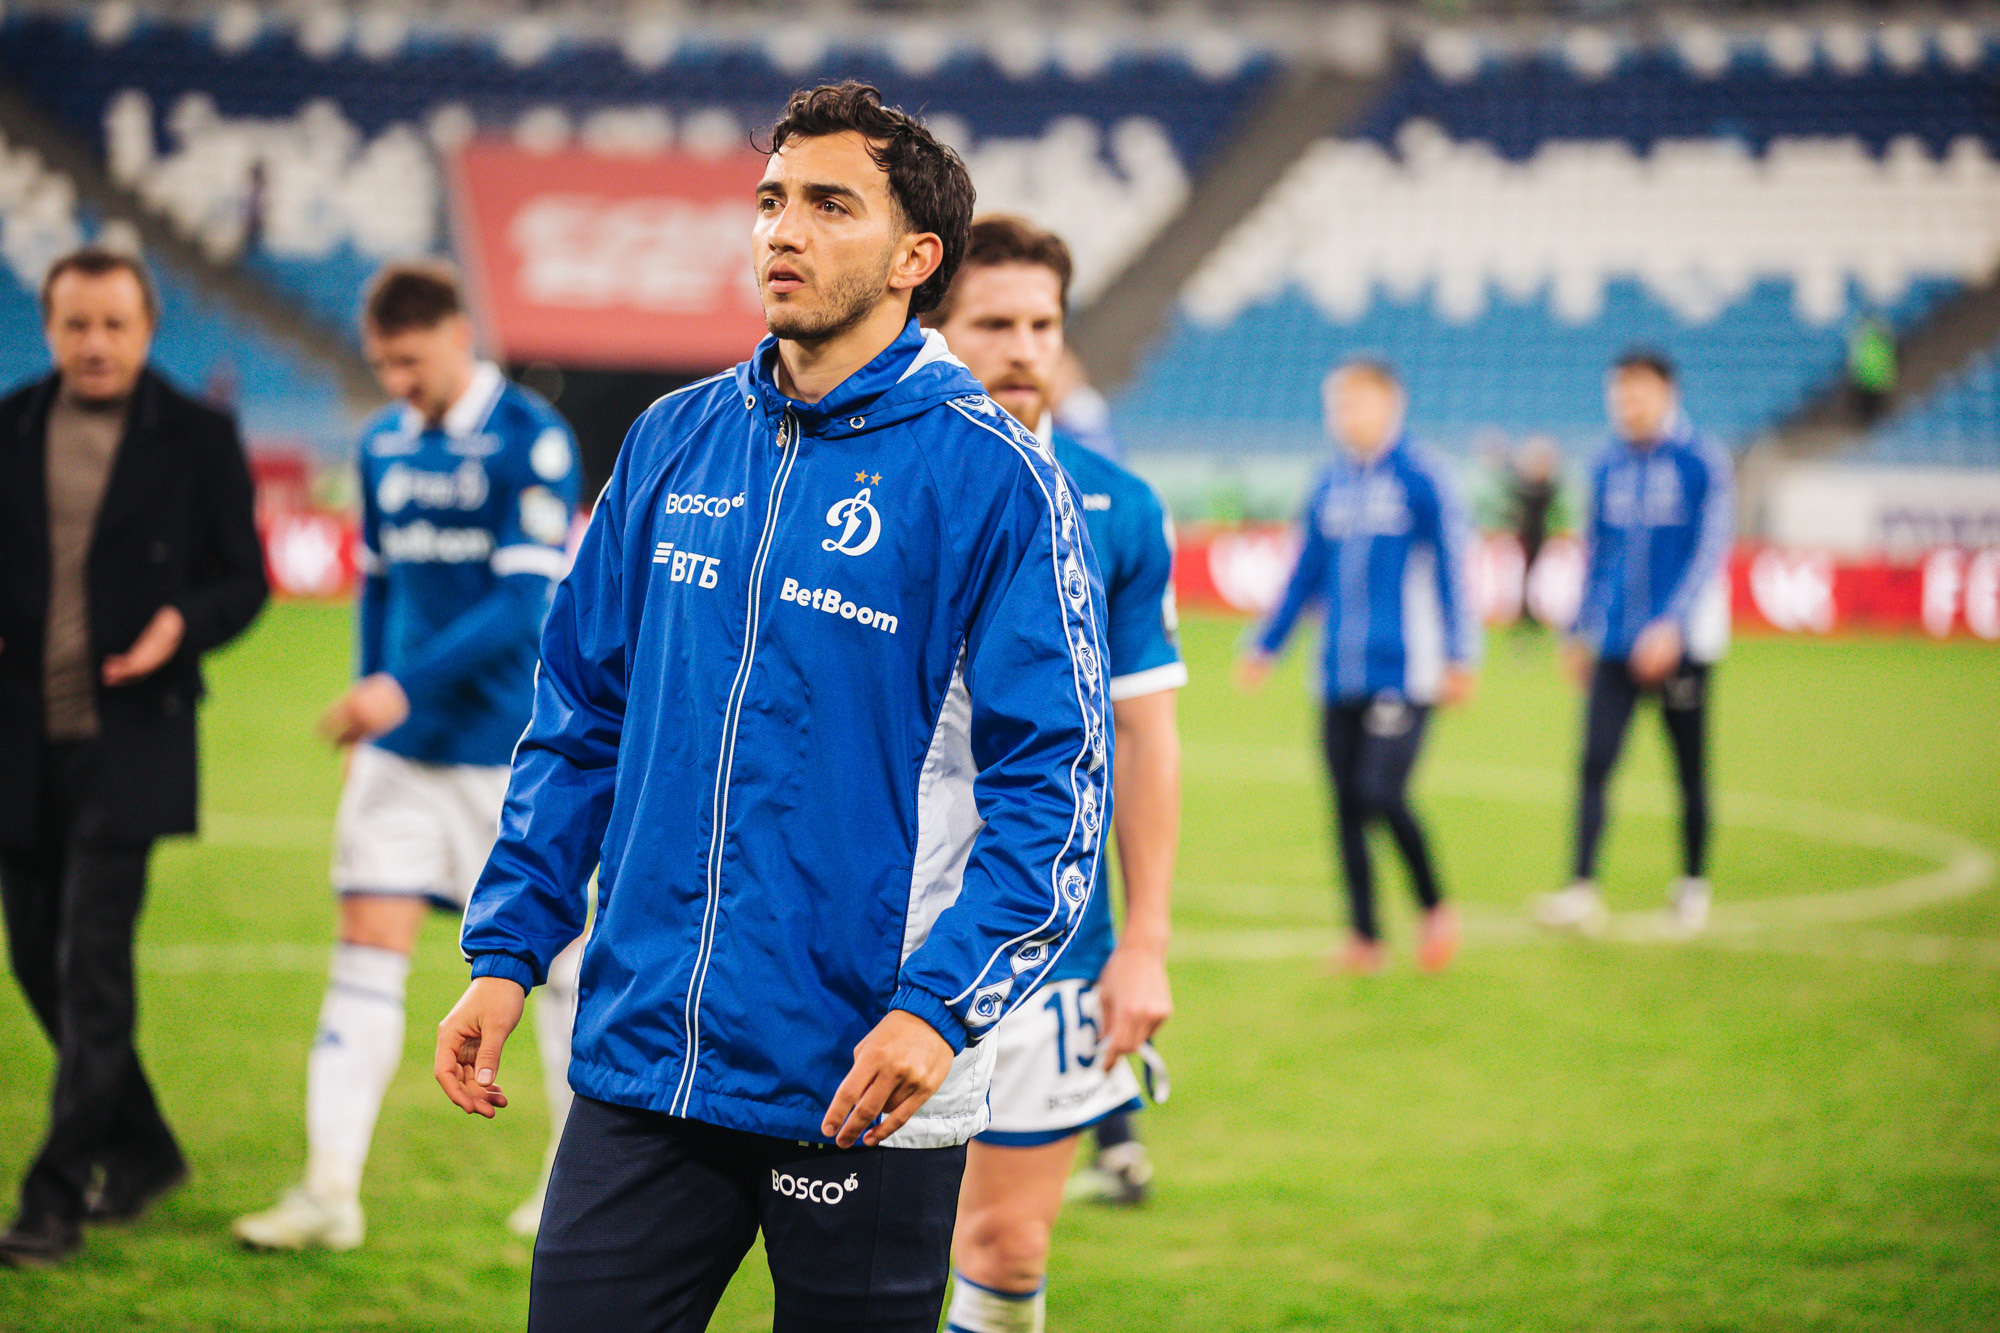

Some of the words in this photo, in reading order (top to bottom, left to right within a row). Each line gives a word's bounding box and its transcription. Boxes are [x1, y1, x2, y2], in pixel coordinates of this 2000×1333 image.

[665, 492, 731, 518] BOSCO
[670, 550, 721, 590] ВТБ
[779, 577, 899, 635] BetBoom
[1043, 985, 1101, 1075] 15
[771, 1168, 845, 1205] BOSCO
